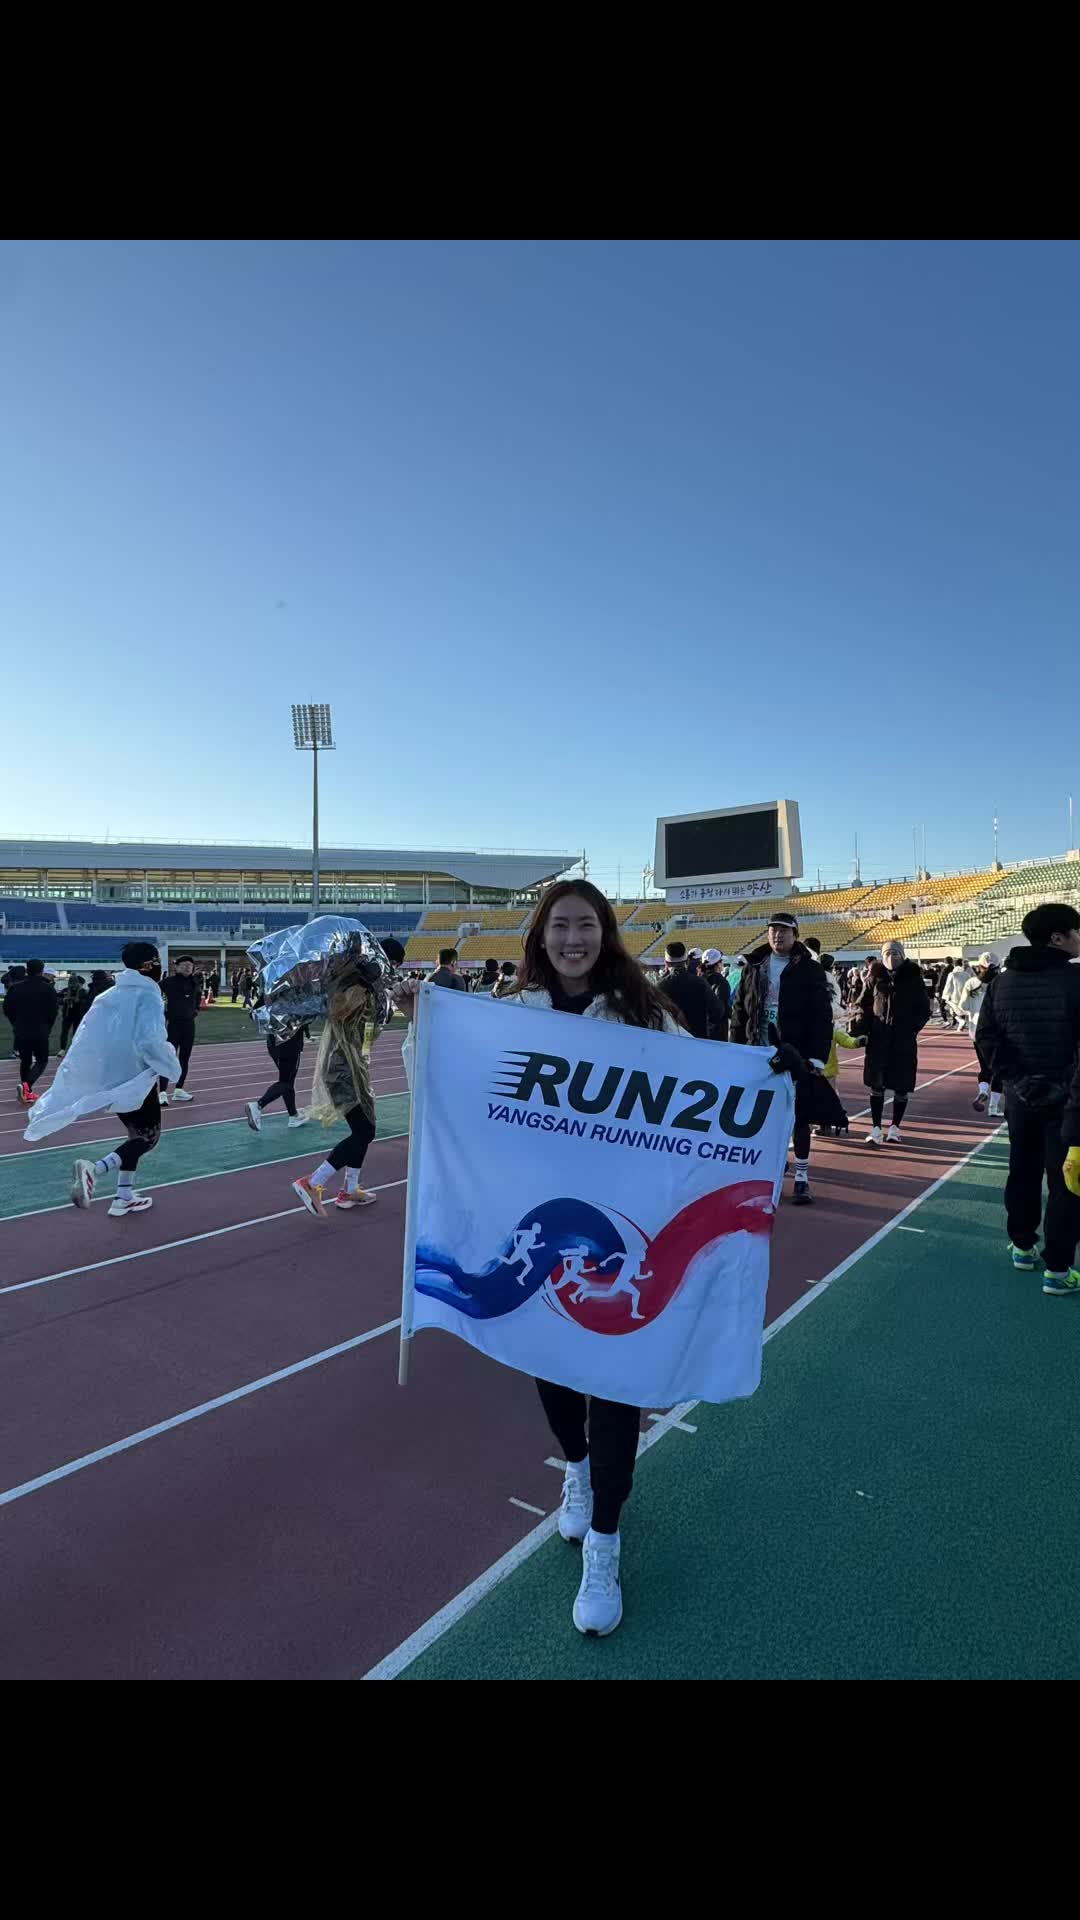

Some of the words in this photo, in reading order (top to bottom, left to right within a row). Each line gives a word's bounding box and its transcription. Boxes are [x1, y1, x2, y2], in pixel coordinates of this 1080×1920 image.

[747, 880, 772, 894] 양산
[489, 1051, 775, 1138] RUN2U
[487, 1103, 587, 1137] YANGSAN
[590, 1124, 692, 1156] RUNNING
[697, 1141, 762, 1166] CREW
